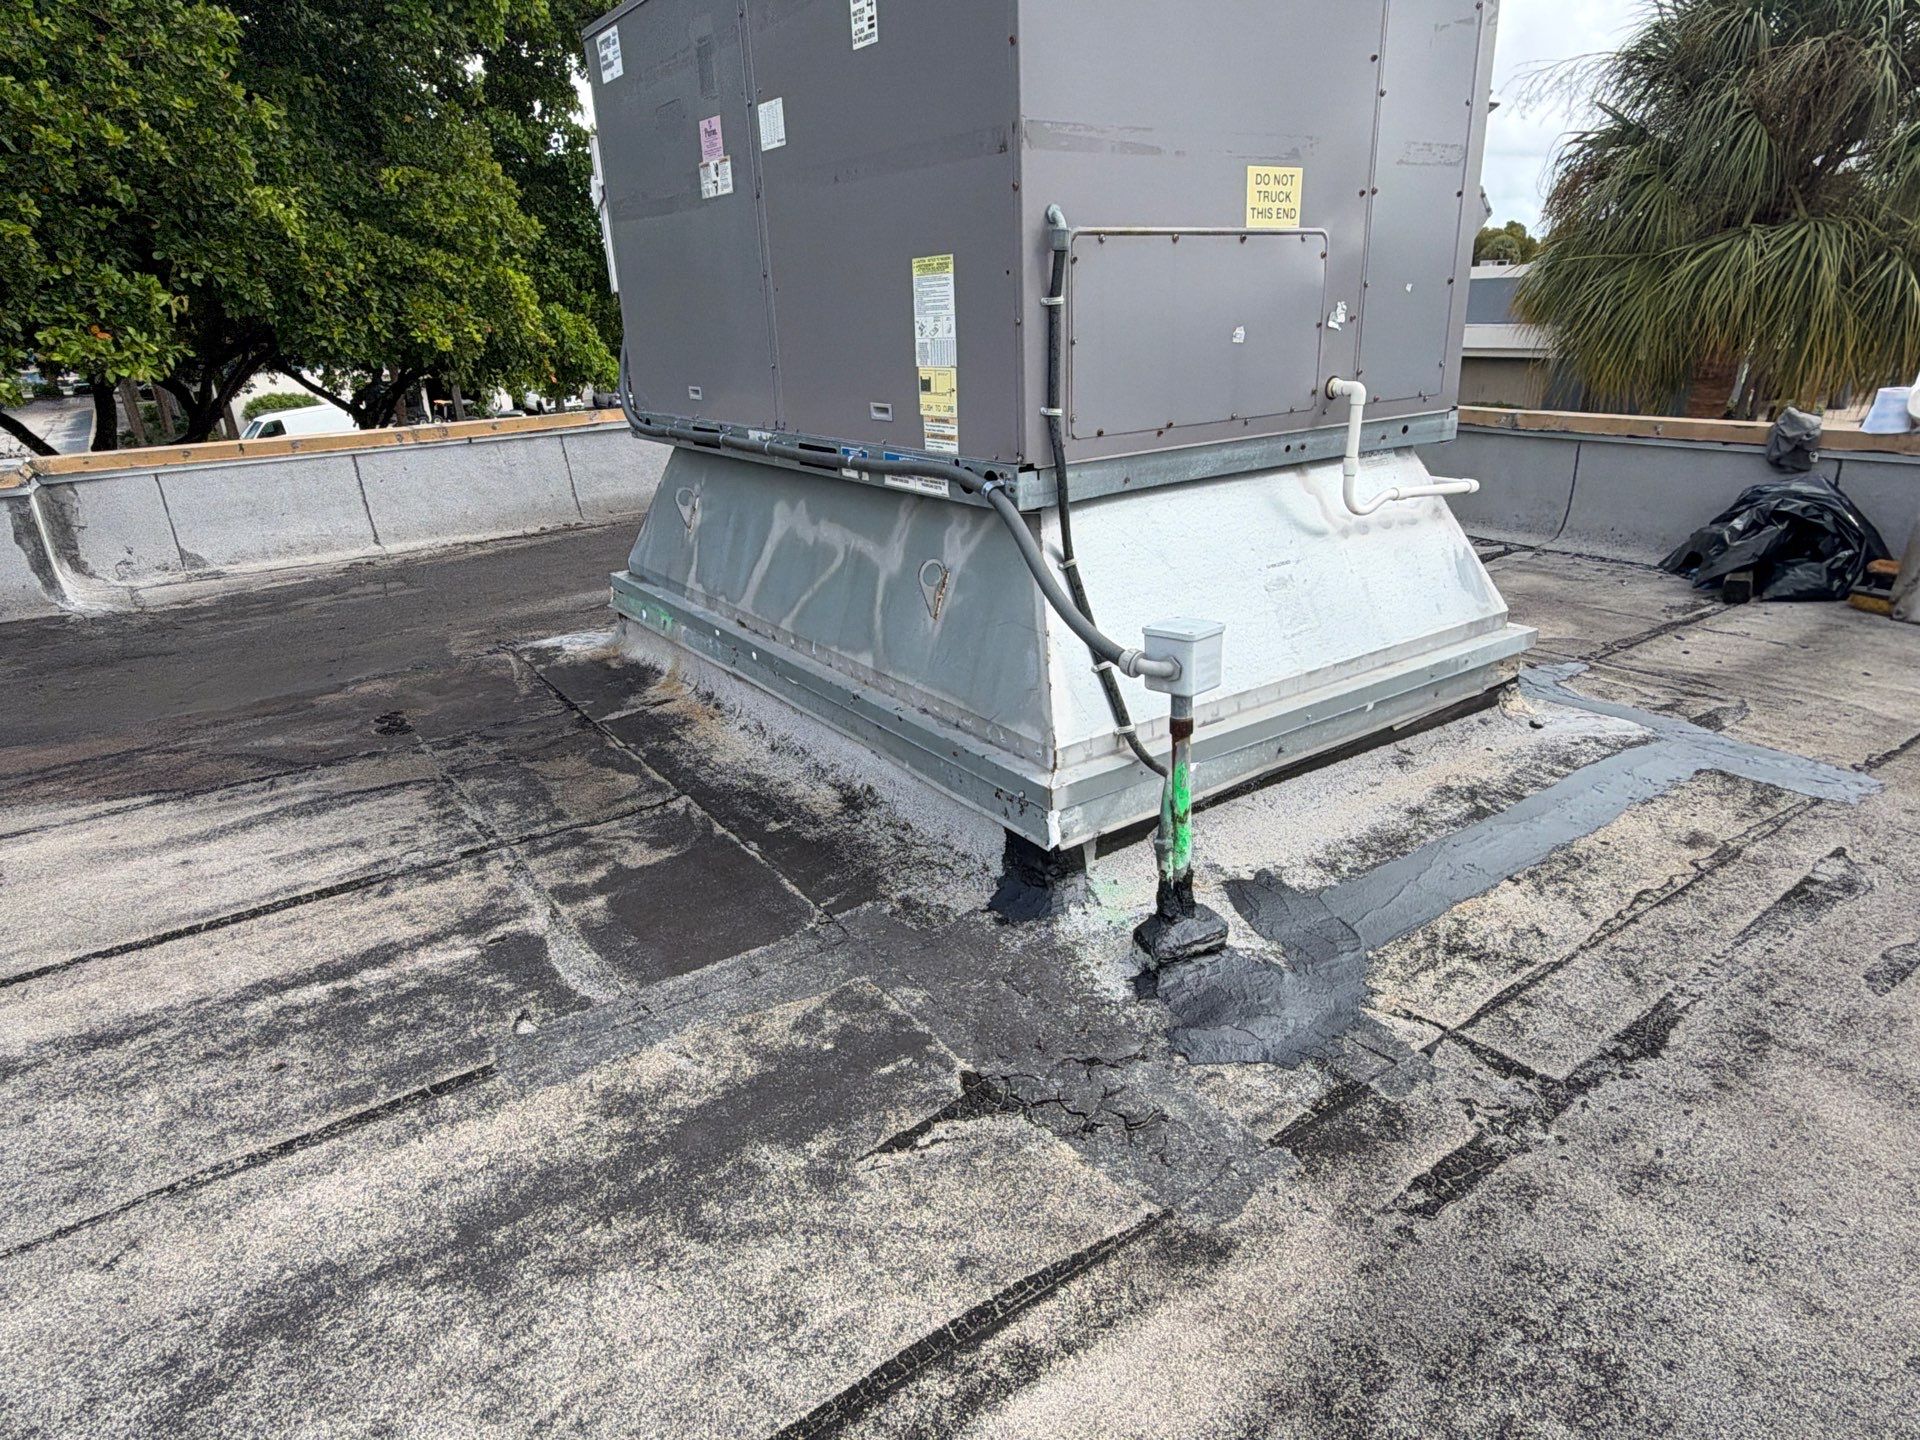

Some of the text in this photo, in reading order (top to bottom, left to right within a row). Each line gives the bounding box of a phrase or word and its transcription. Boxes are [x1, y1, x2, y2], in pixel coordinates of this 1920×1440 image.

[1255, 173, 1295, 186] DO NOT
[1256, 190, 1292, 203] TRUCK
[1250, 207, 1297, 220] THIS END
